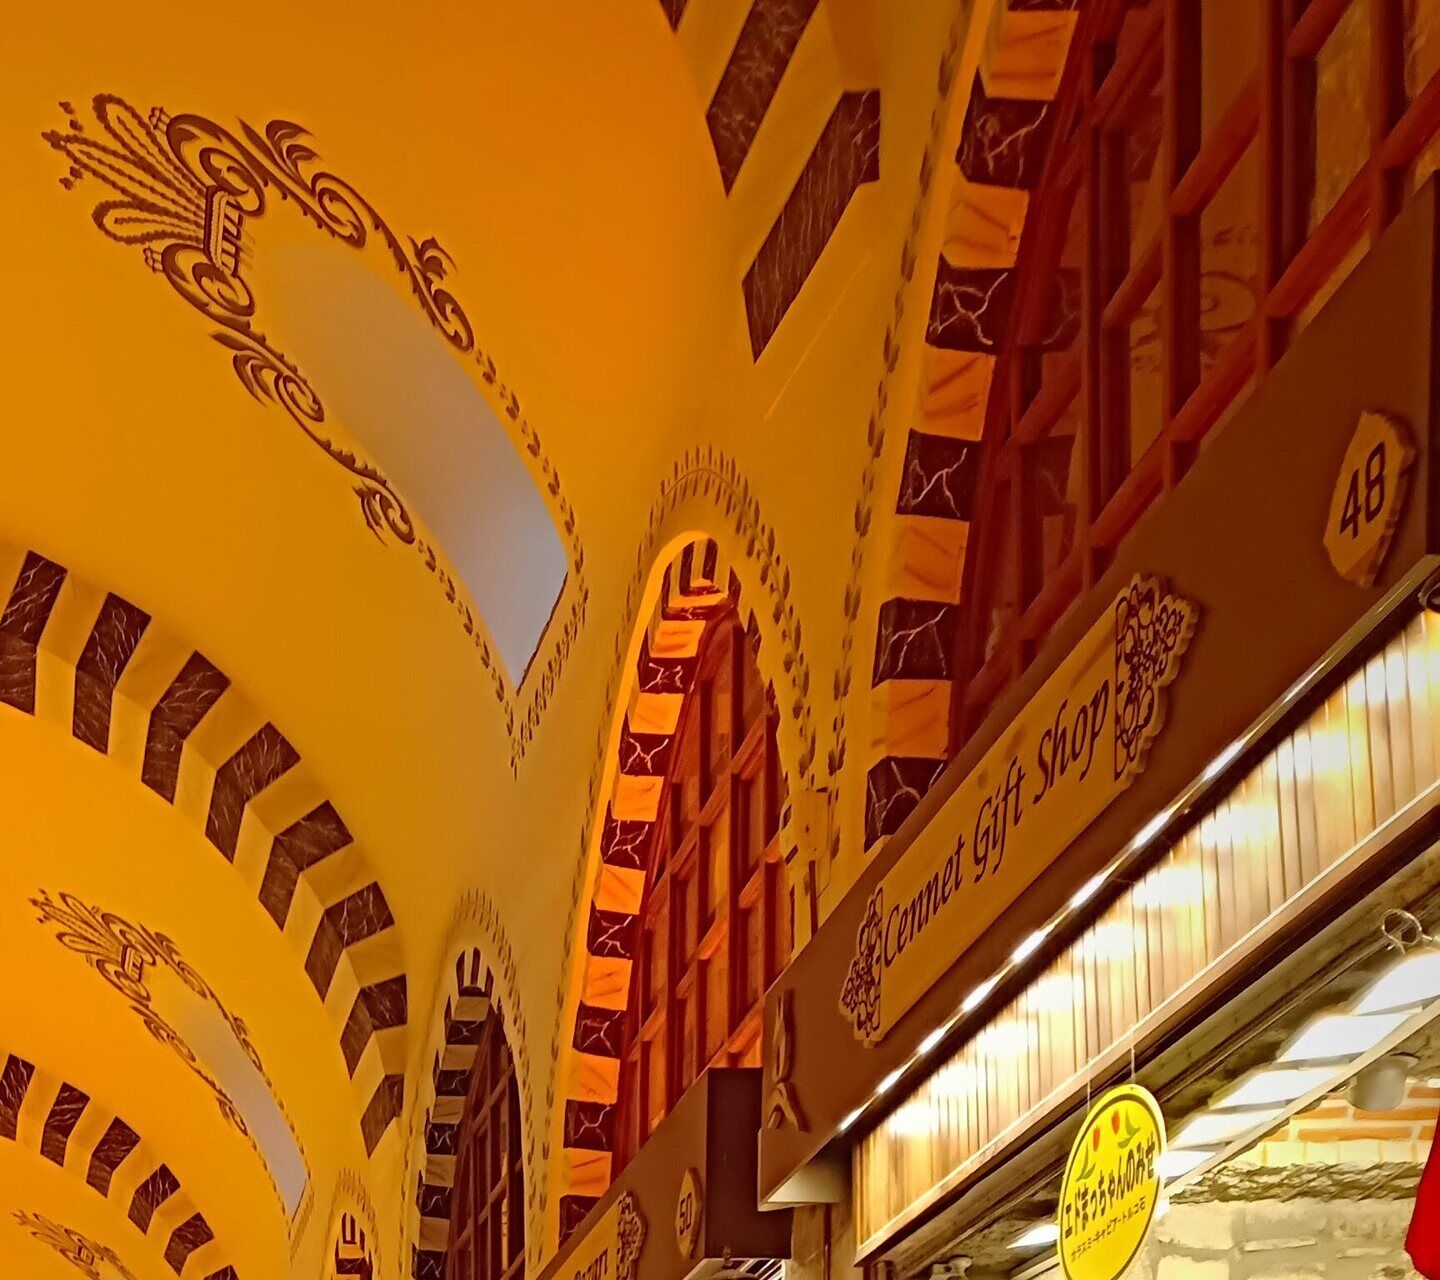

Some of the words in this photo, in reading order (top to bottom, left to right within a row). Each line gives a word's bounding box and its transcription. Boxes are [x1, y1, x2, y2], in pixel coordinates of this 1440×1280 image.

[1340, 441, 1386, 540] 48
[883, 833, 966, 968] Cennet
[972, 756, 1026, 884] Gift
[1032, 679, 1109, 805] Shop
